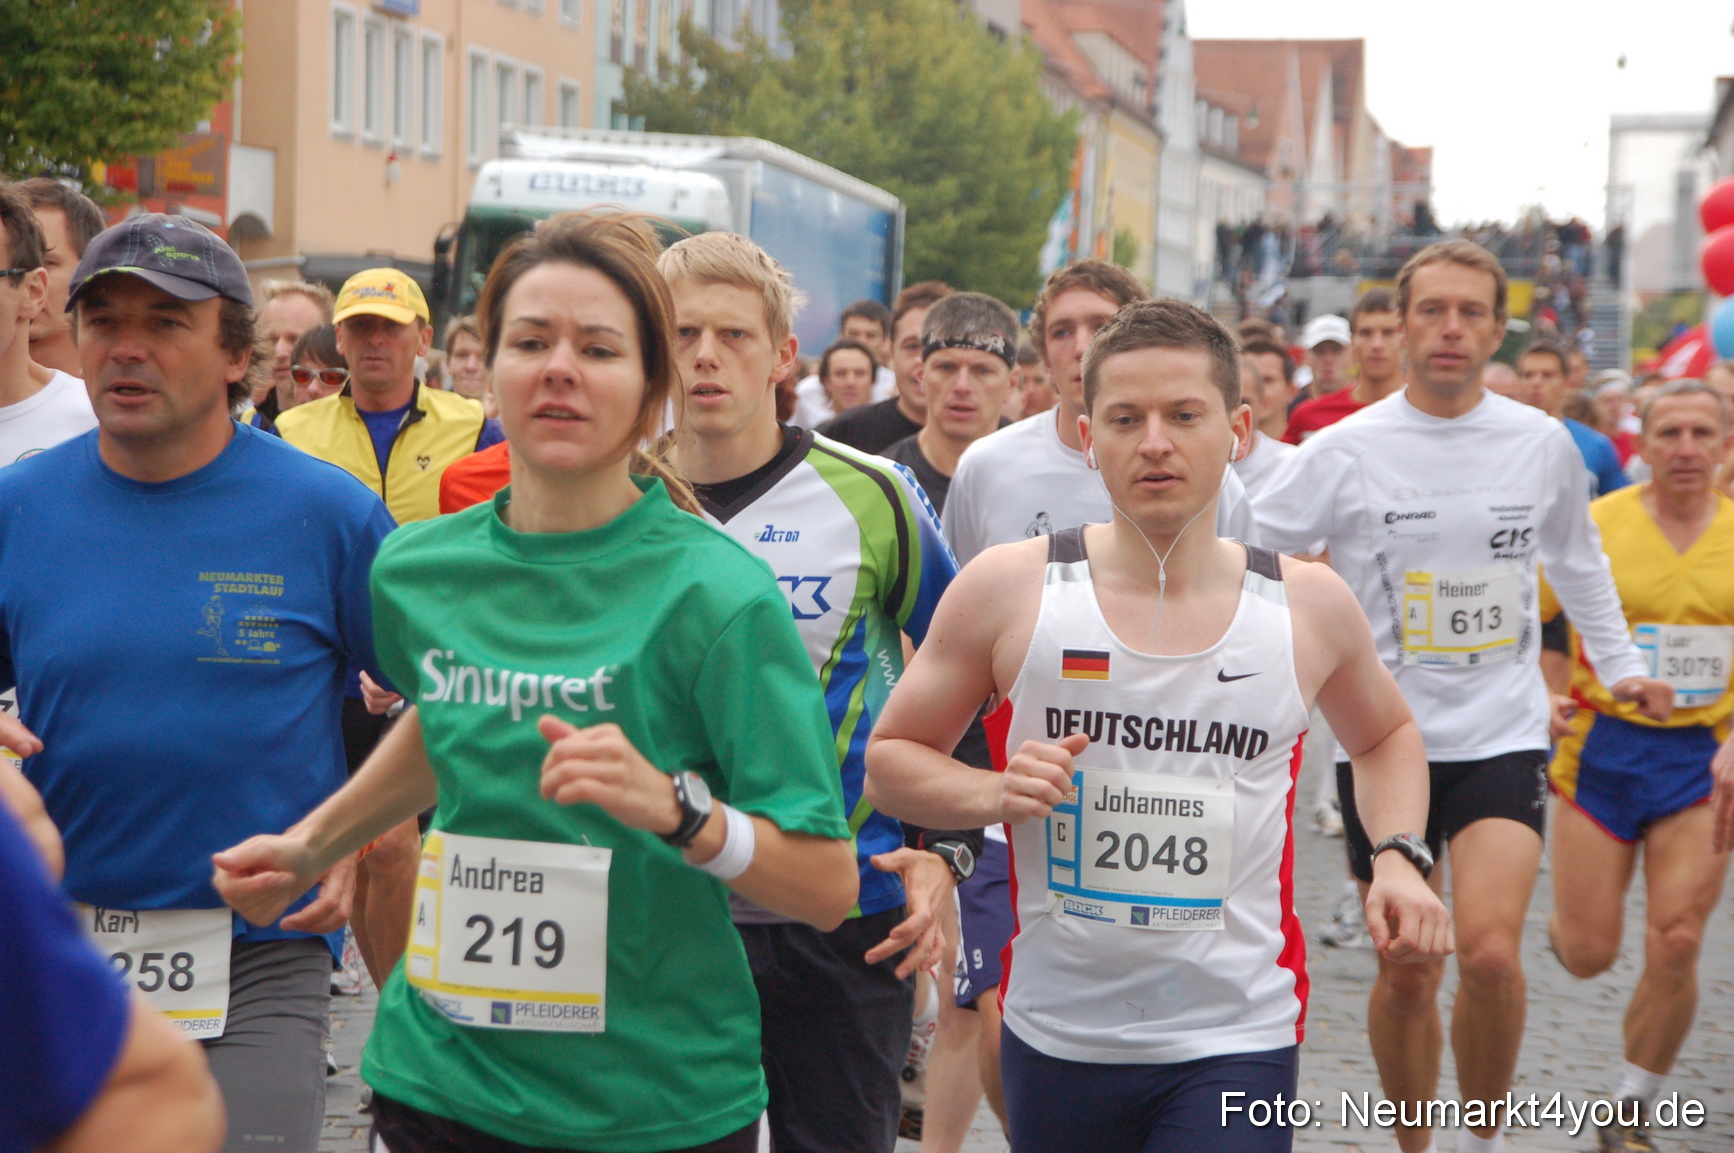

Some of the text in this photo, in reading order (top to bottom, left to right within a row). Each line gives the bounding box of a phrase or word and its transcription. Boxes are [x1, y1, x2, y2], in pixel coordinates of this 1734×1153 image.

[199, 572, 284, 585] NEUMARKTER
[214, 583, 284, 596] STADTLAUF
[1439, 579, 1488, 598] Heiner
[1409, 608, 1417, 620] A
[1451, 605, 1503, 635] 613
[239, 628, 275, 639] 5 Jahre
[1667, 656, 1724, 677] 3079
[421, 648, 616, 722] Sinupret
[1045, 706, 1270, 761] DEUTSCHLAND
[1094, 785, 1205, 818] Johannes
[1057, 822, 1066, 842] C
[1094, 830, 1208, 876] 2048
[450, 853, 544, 894] Andrea
[94, 906, 140, 933] Karl
[418, 901, 426, 926] A
[1063, 899, 1221, 922] BOCK PFLEIDERER
[463, 914, 566, 969] 219
[515, 1003, 600, 1020] PFLEIDERER
